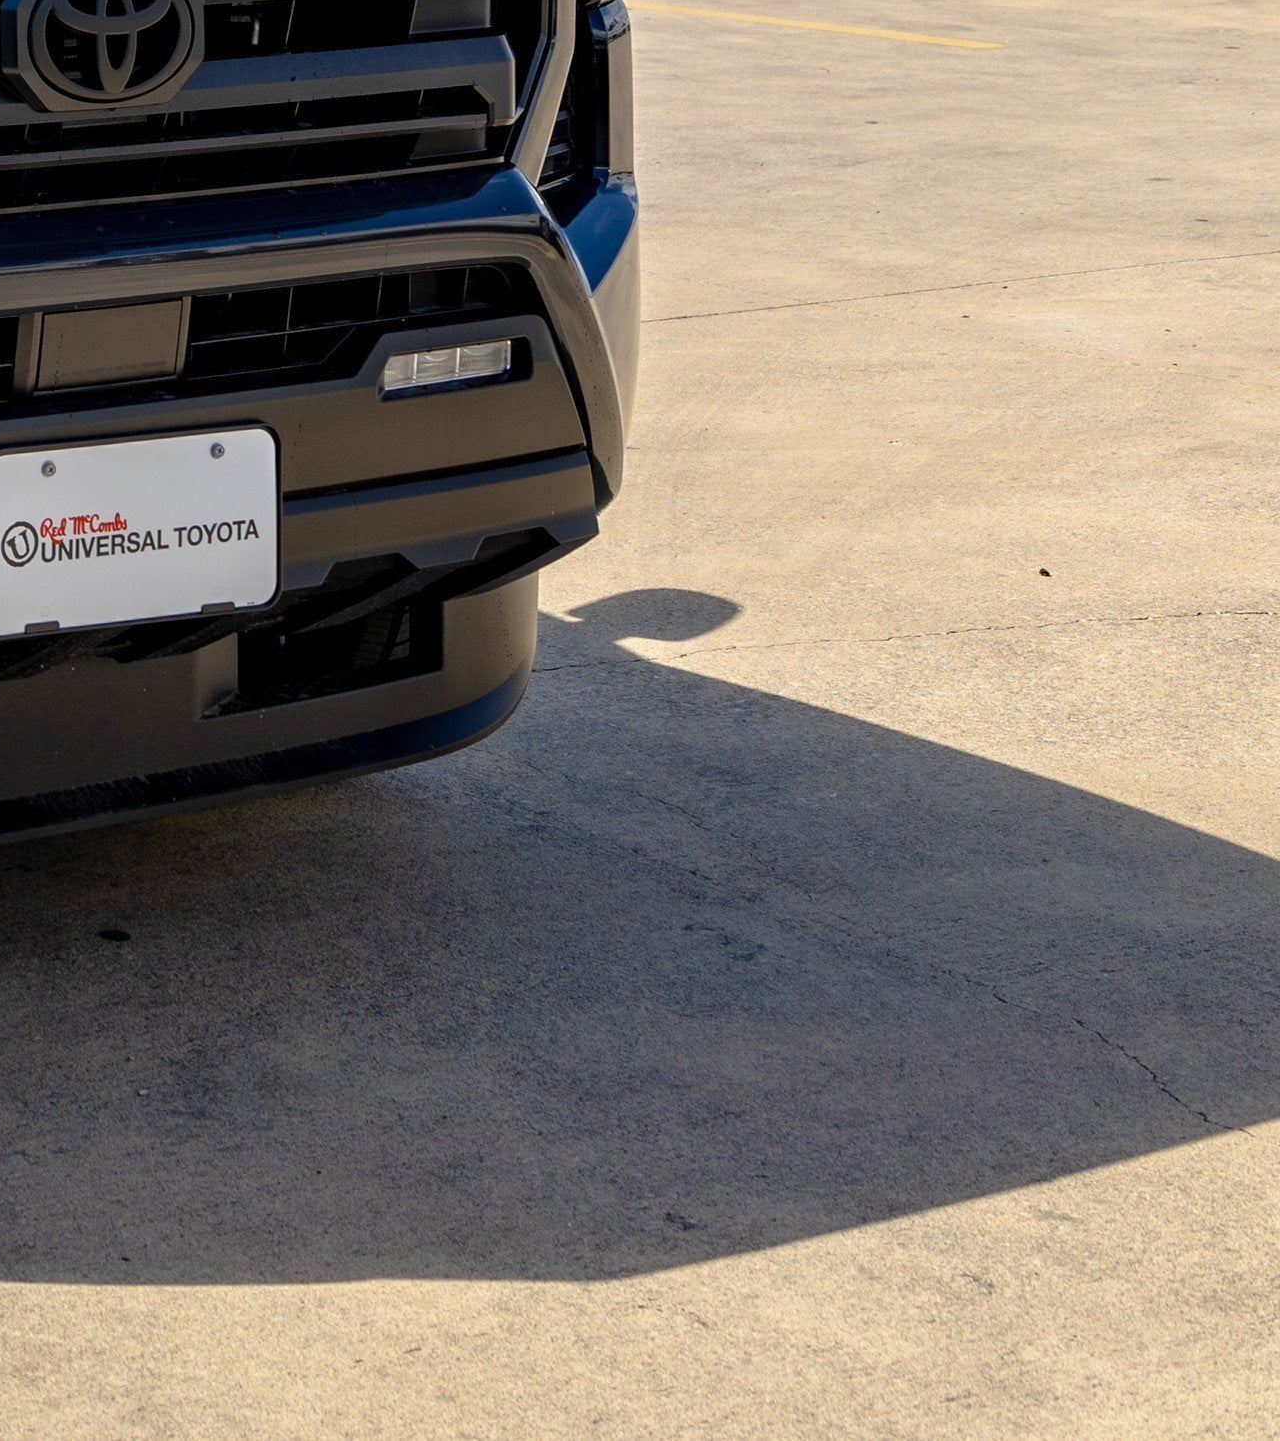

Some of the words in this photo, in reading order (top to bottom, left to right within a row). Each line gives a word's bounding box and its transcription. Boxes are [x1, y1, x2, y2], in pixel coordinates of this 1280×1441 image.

[40, 518, 66, 545] Red
[41, 529, 170, 563] UNIVERSAL
[173, 519, 260, 548] TOYOTA
